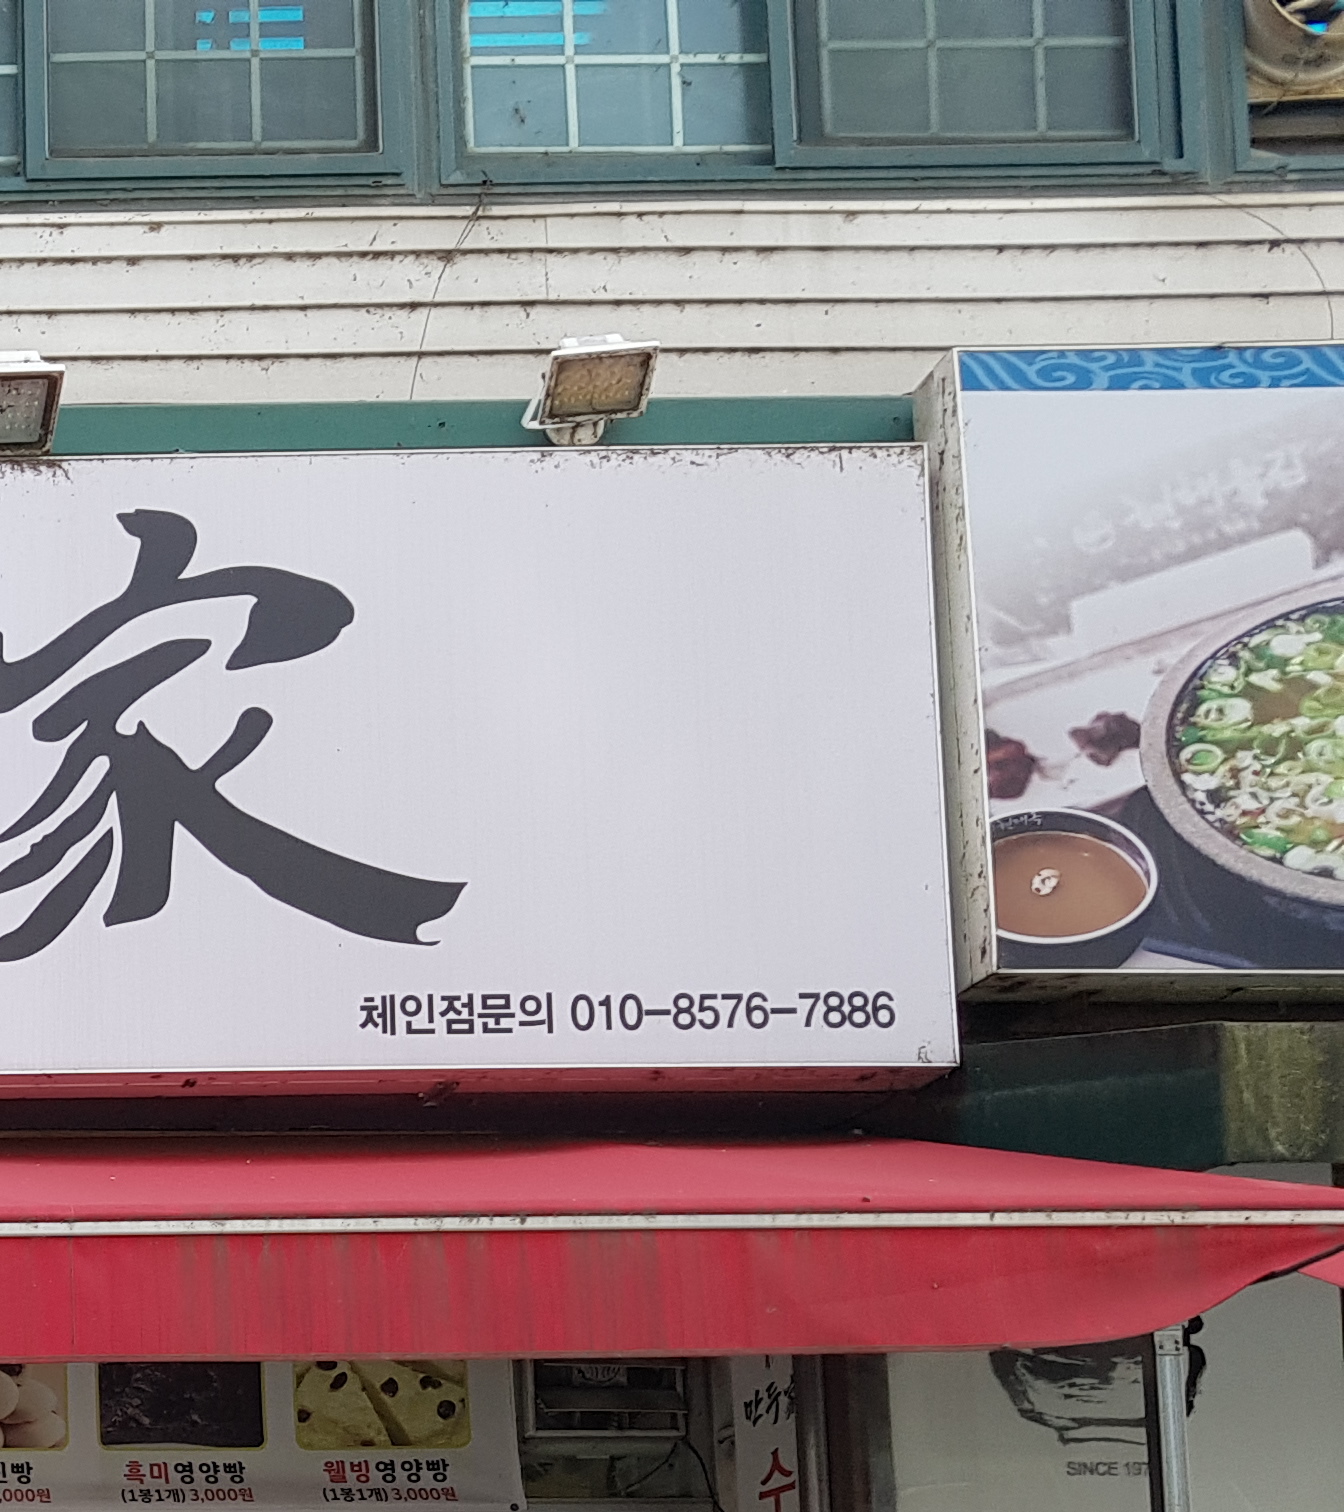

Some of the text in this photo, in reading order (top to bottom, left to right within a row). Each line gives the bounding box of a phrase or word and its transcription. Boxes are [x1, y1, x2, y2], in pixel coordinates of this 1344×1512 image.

[359, 991, 895, 1035] 체인점문의 010-8576-7886
[124, 1461, 249, 1484] 흑미영양빵
[323, 1459, 449, 1483] 웰빙영양빵
[1066, 1461, 1119, 1476] SINCE
[121, 1483, 254, 1503] (1봉1개) 3,000원
[323, 1487, 458, 1502] (1봉1개) 3,000원
